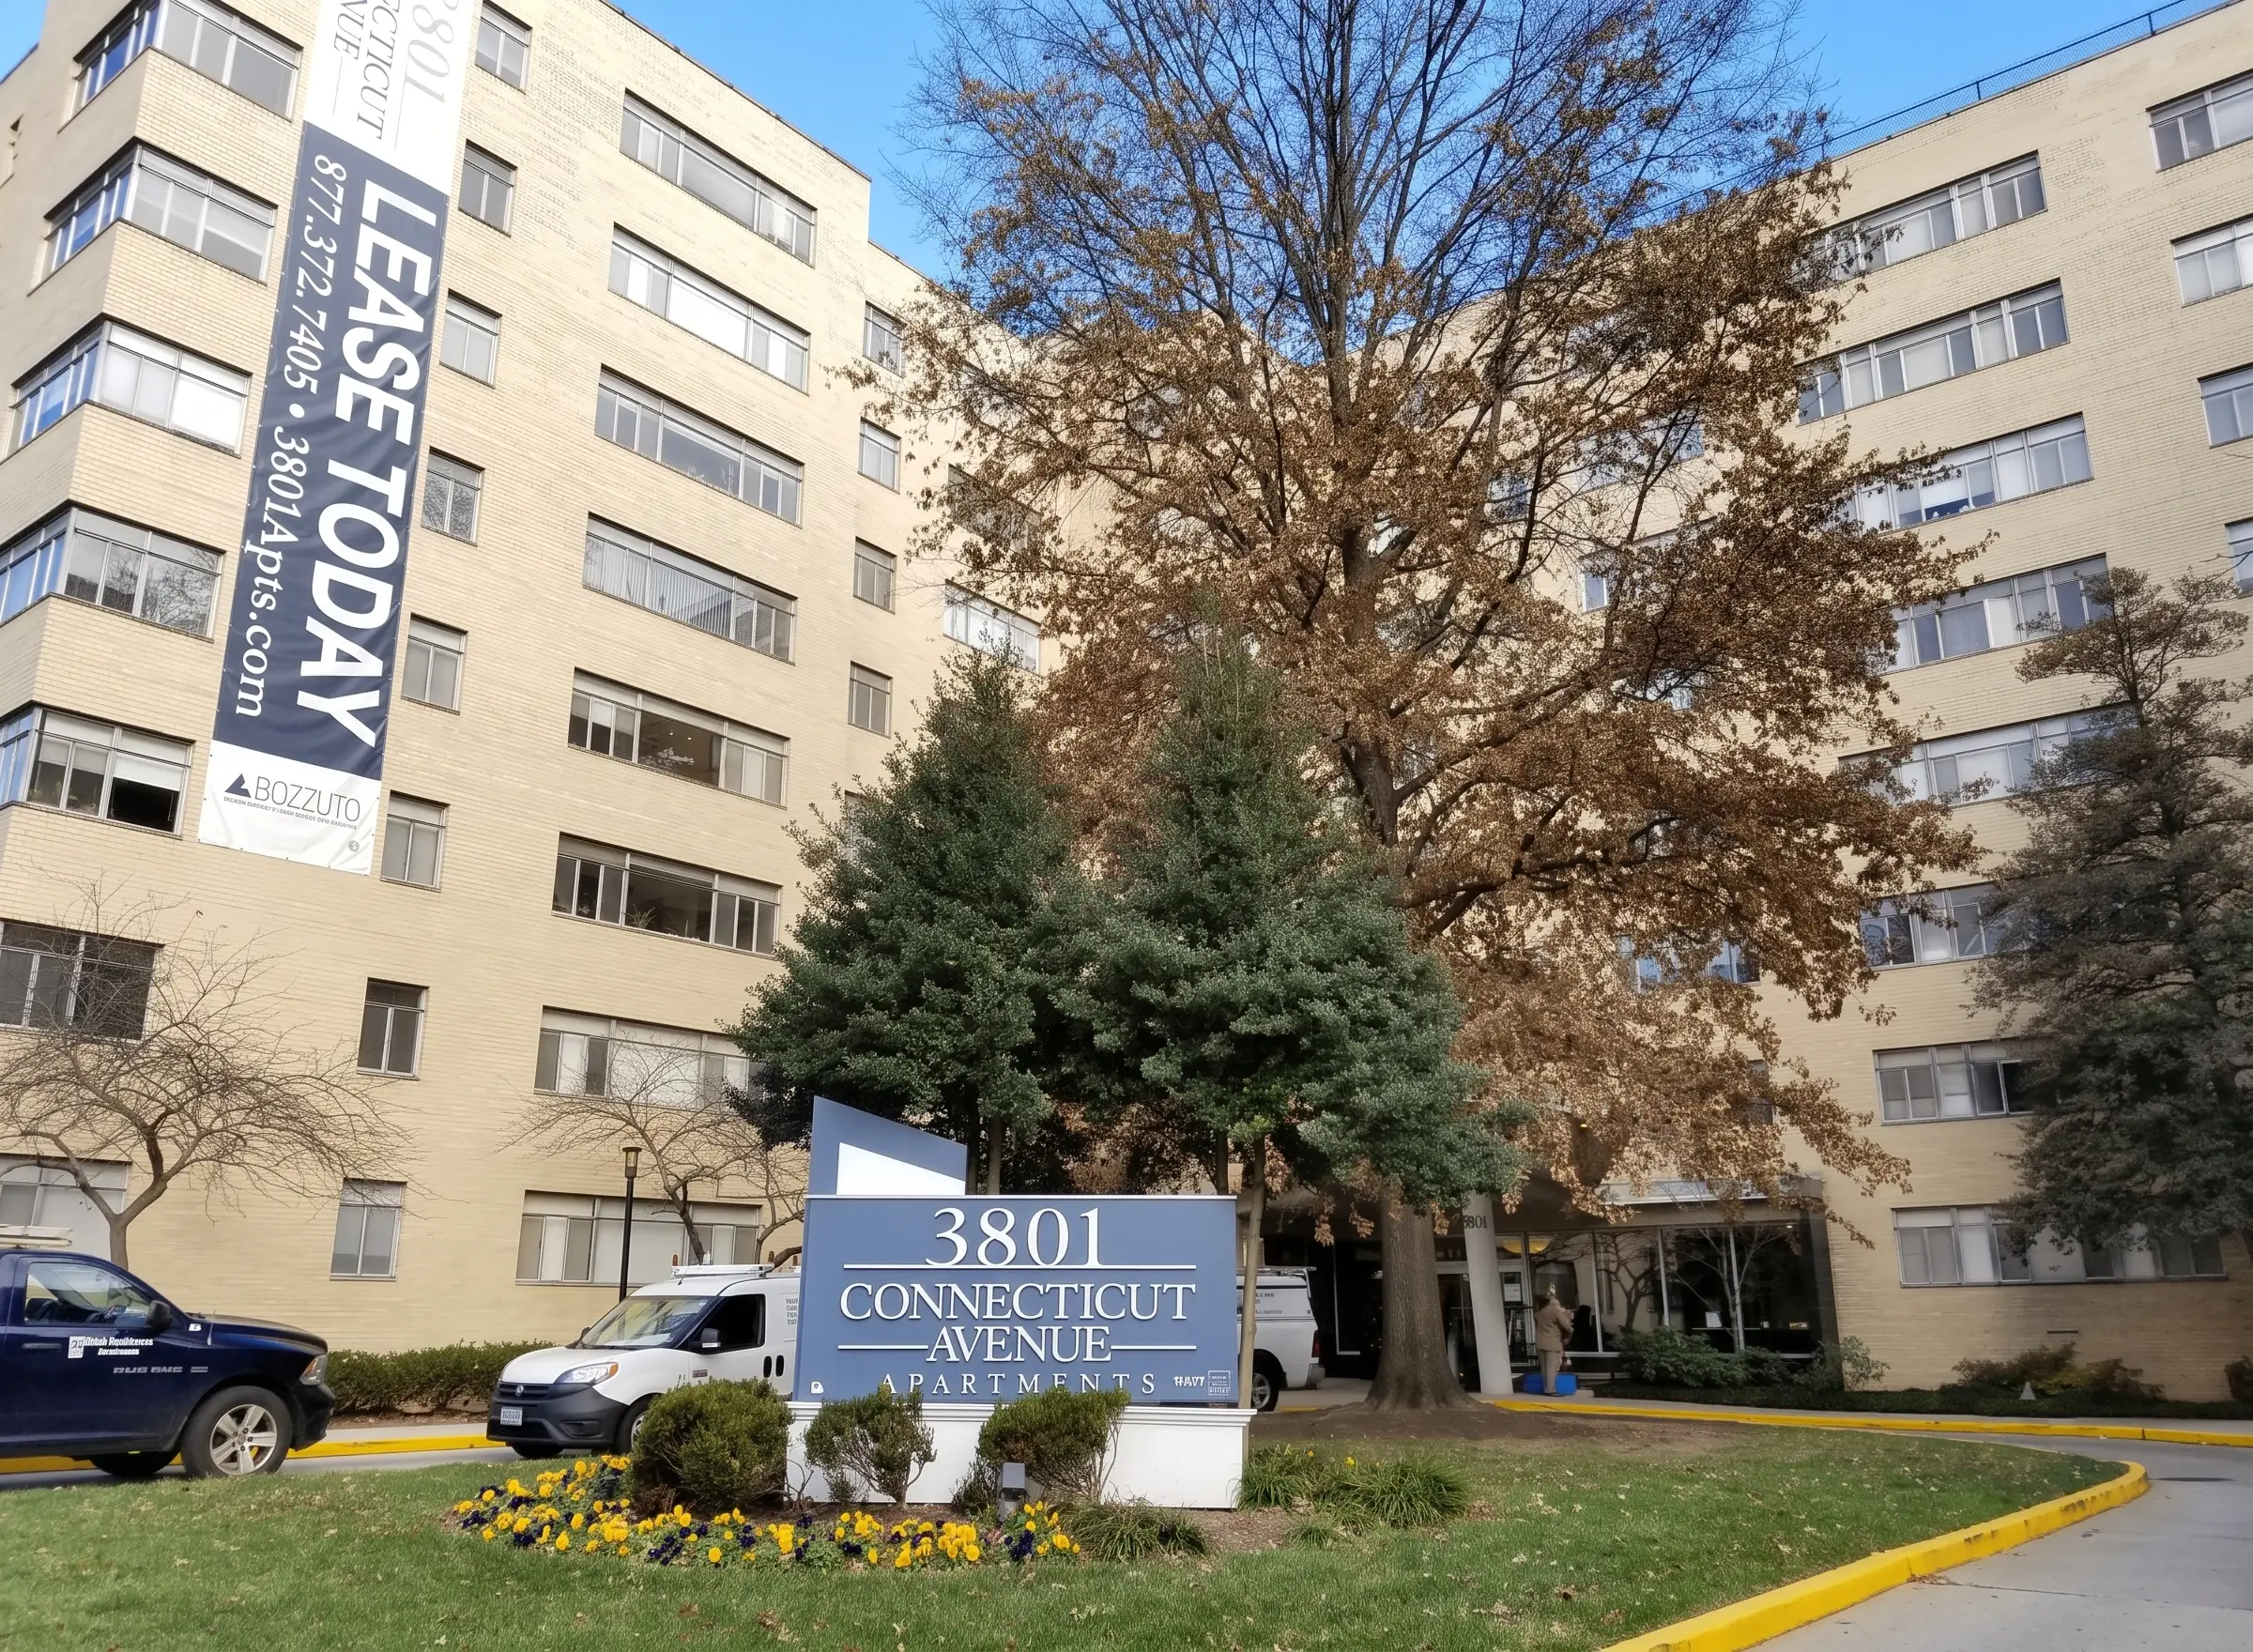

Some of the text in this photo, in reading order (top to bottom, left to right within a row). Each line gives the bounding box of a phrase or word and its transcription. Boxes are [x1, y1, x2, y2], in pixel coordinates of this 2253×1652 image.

[406, 0, 459, 103] 801
[284, 154, 347, 394] 877.372.7405
[297, 179, 437, 748] LEASE TODAY
[236, 425, 310, 718] 3801Apts.com
[254, 775, 360, 822] BOZZUTO
[925, 1207, 1105, 1266] 3801
[839, 1282, 1197, 1321] CONNECTICUT
[926, 1325, 1112, 1363] AVENUE
[881, 1373, 1156, 1394] APARTMENTS
